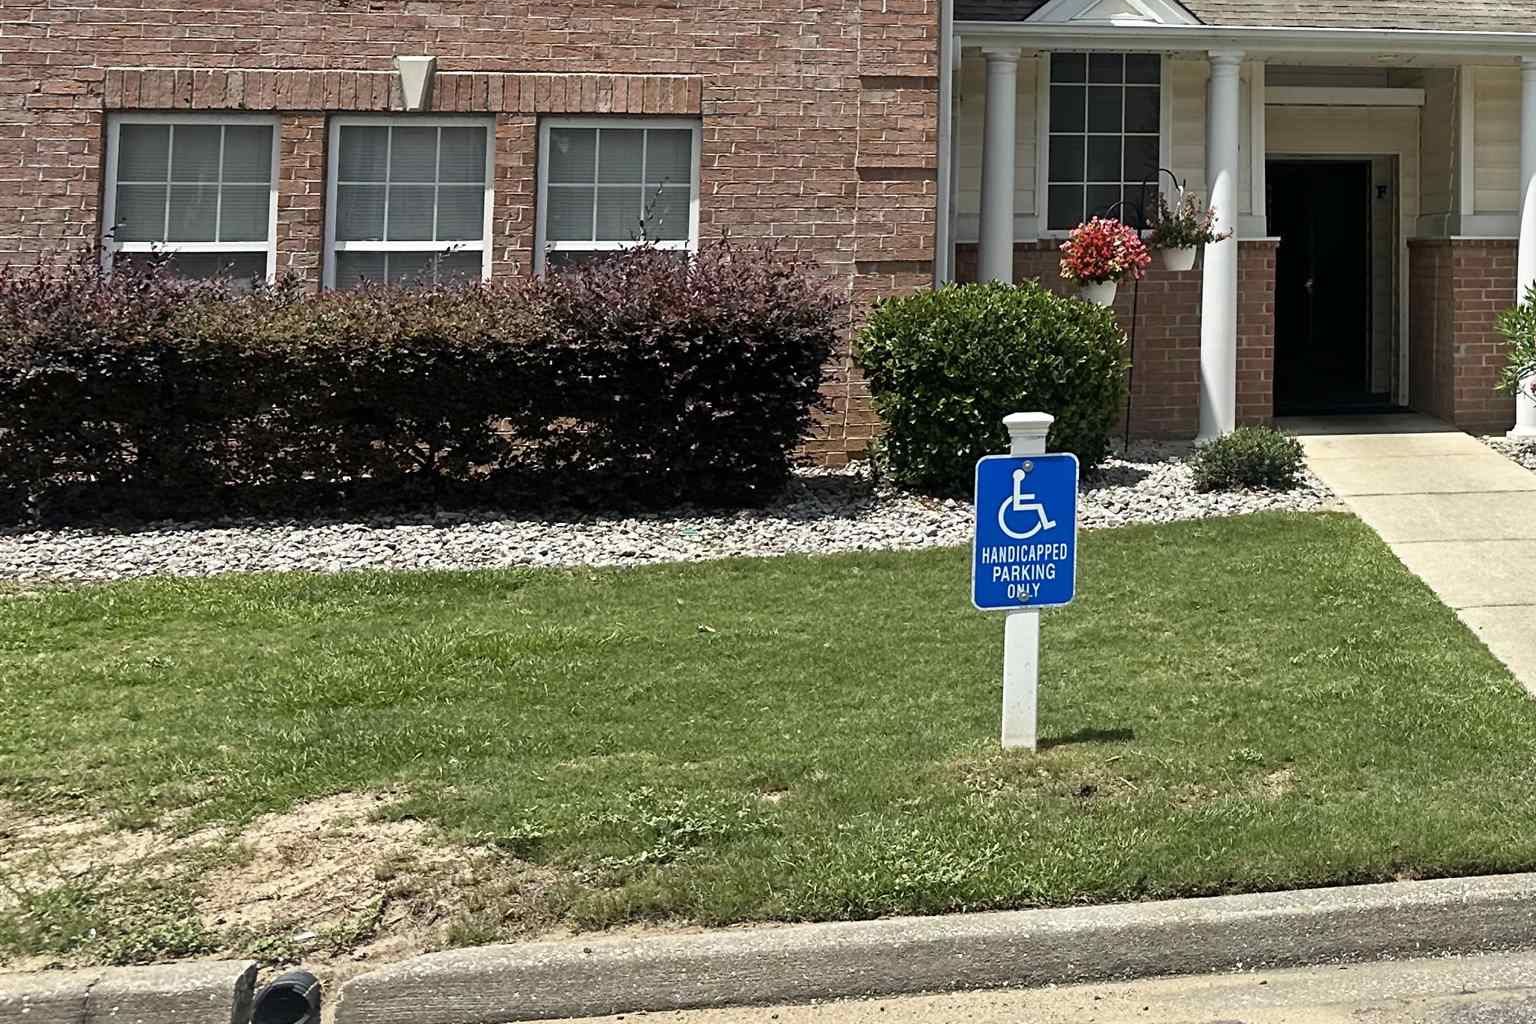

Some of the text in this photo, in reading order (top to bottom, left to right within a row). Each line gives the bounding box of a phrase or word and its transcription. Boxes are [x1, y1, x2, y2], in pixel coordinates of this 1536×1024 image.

[982, 543, 1068, 564] HANDICAPPED
[992, 563, 1056, 583] PARKING
[1007, 582, 1041, 599] ONLY
